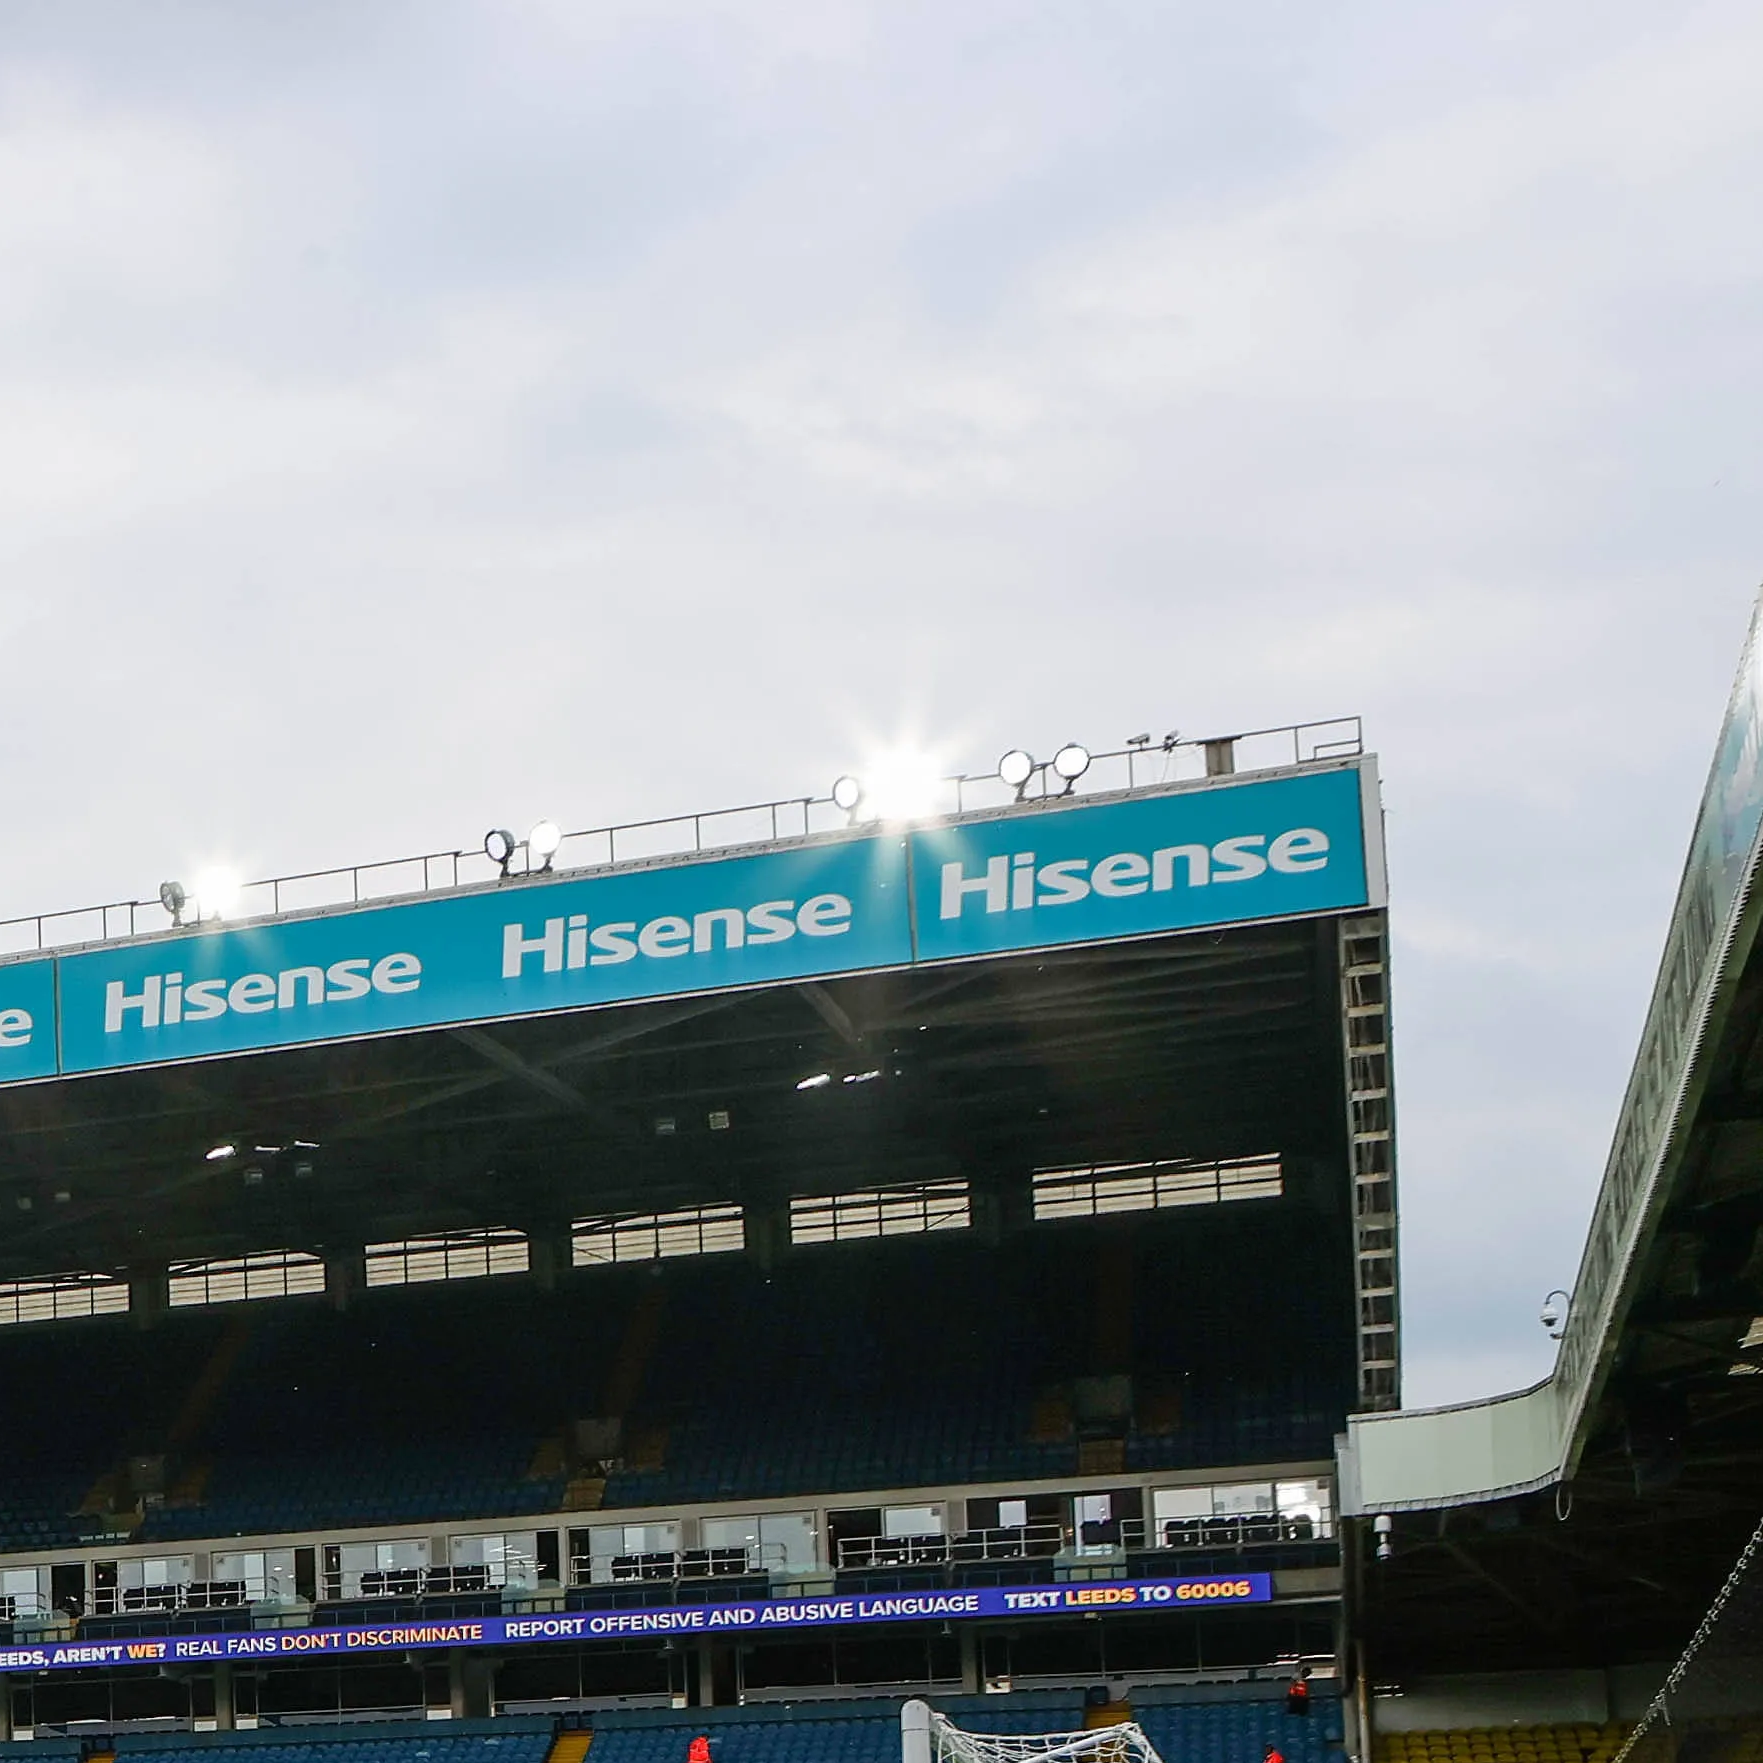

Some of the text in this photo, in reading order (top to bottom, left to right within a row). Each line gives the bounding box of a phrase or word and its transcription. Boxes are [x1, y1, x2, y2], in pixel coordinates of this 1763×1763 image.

[941, 826, 1330, 921] Hisense
[502, 891, 851, 978] Hisense
[106, 950, 420, 1035] Hisense
[506, 1596, 978, 1637] REPORT OFFENSIVE AND ABUSIVE LANGUAGE
[1005, 1581, 1251, 1608] TEXT LEEDS TO 60006
[127, 1643, 165, 1658] WE?
[177, 1641, 222, 1656] REAL
[228, 1637, 276, 1653] FANS
[347, 1625, 482, 1646] DISCRIMINATE
